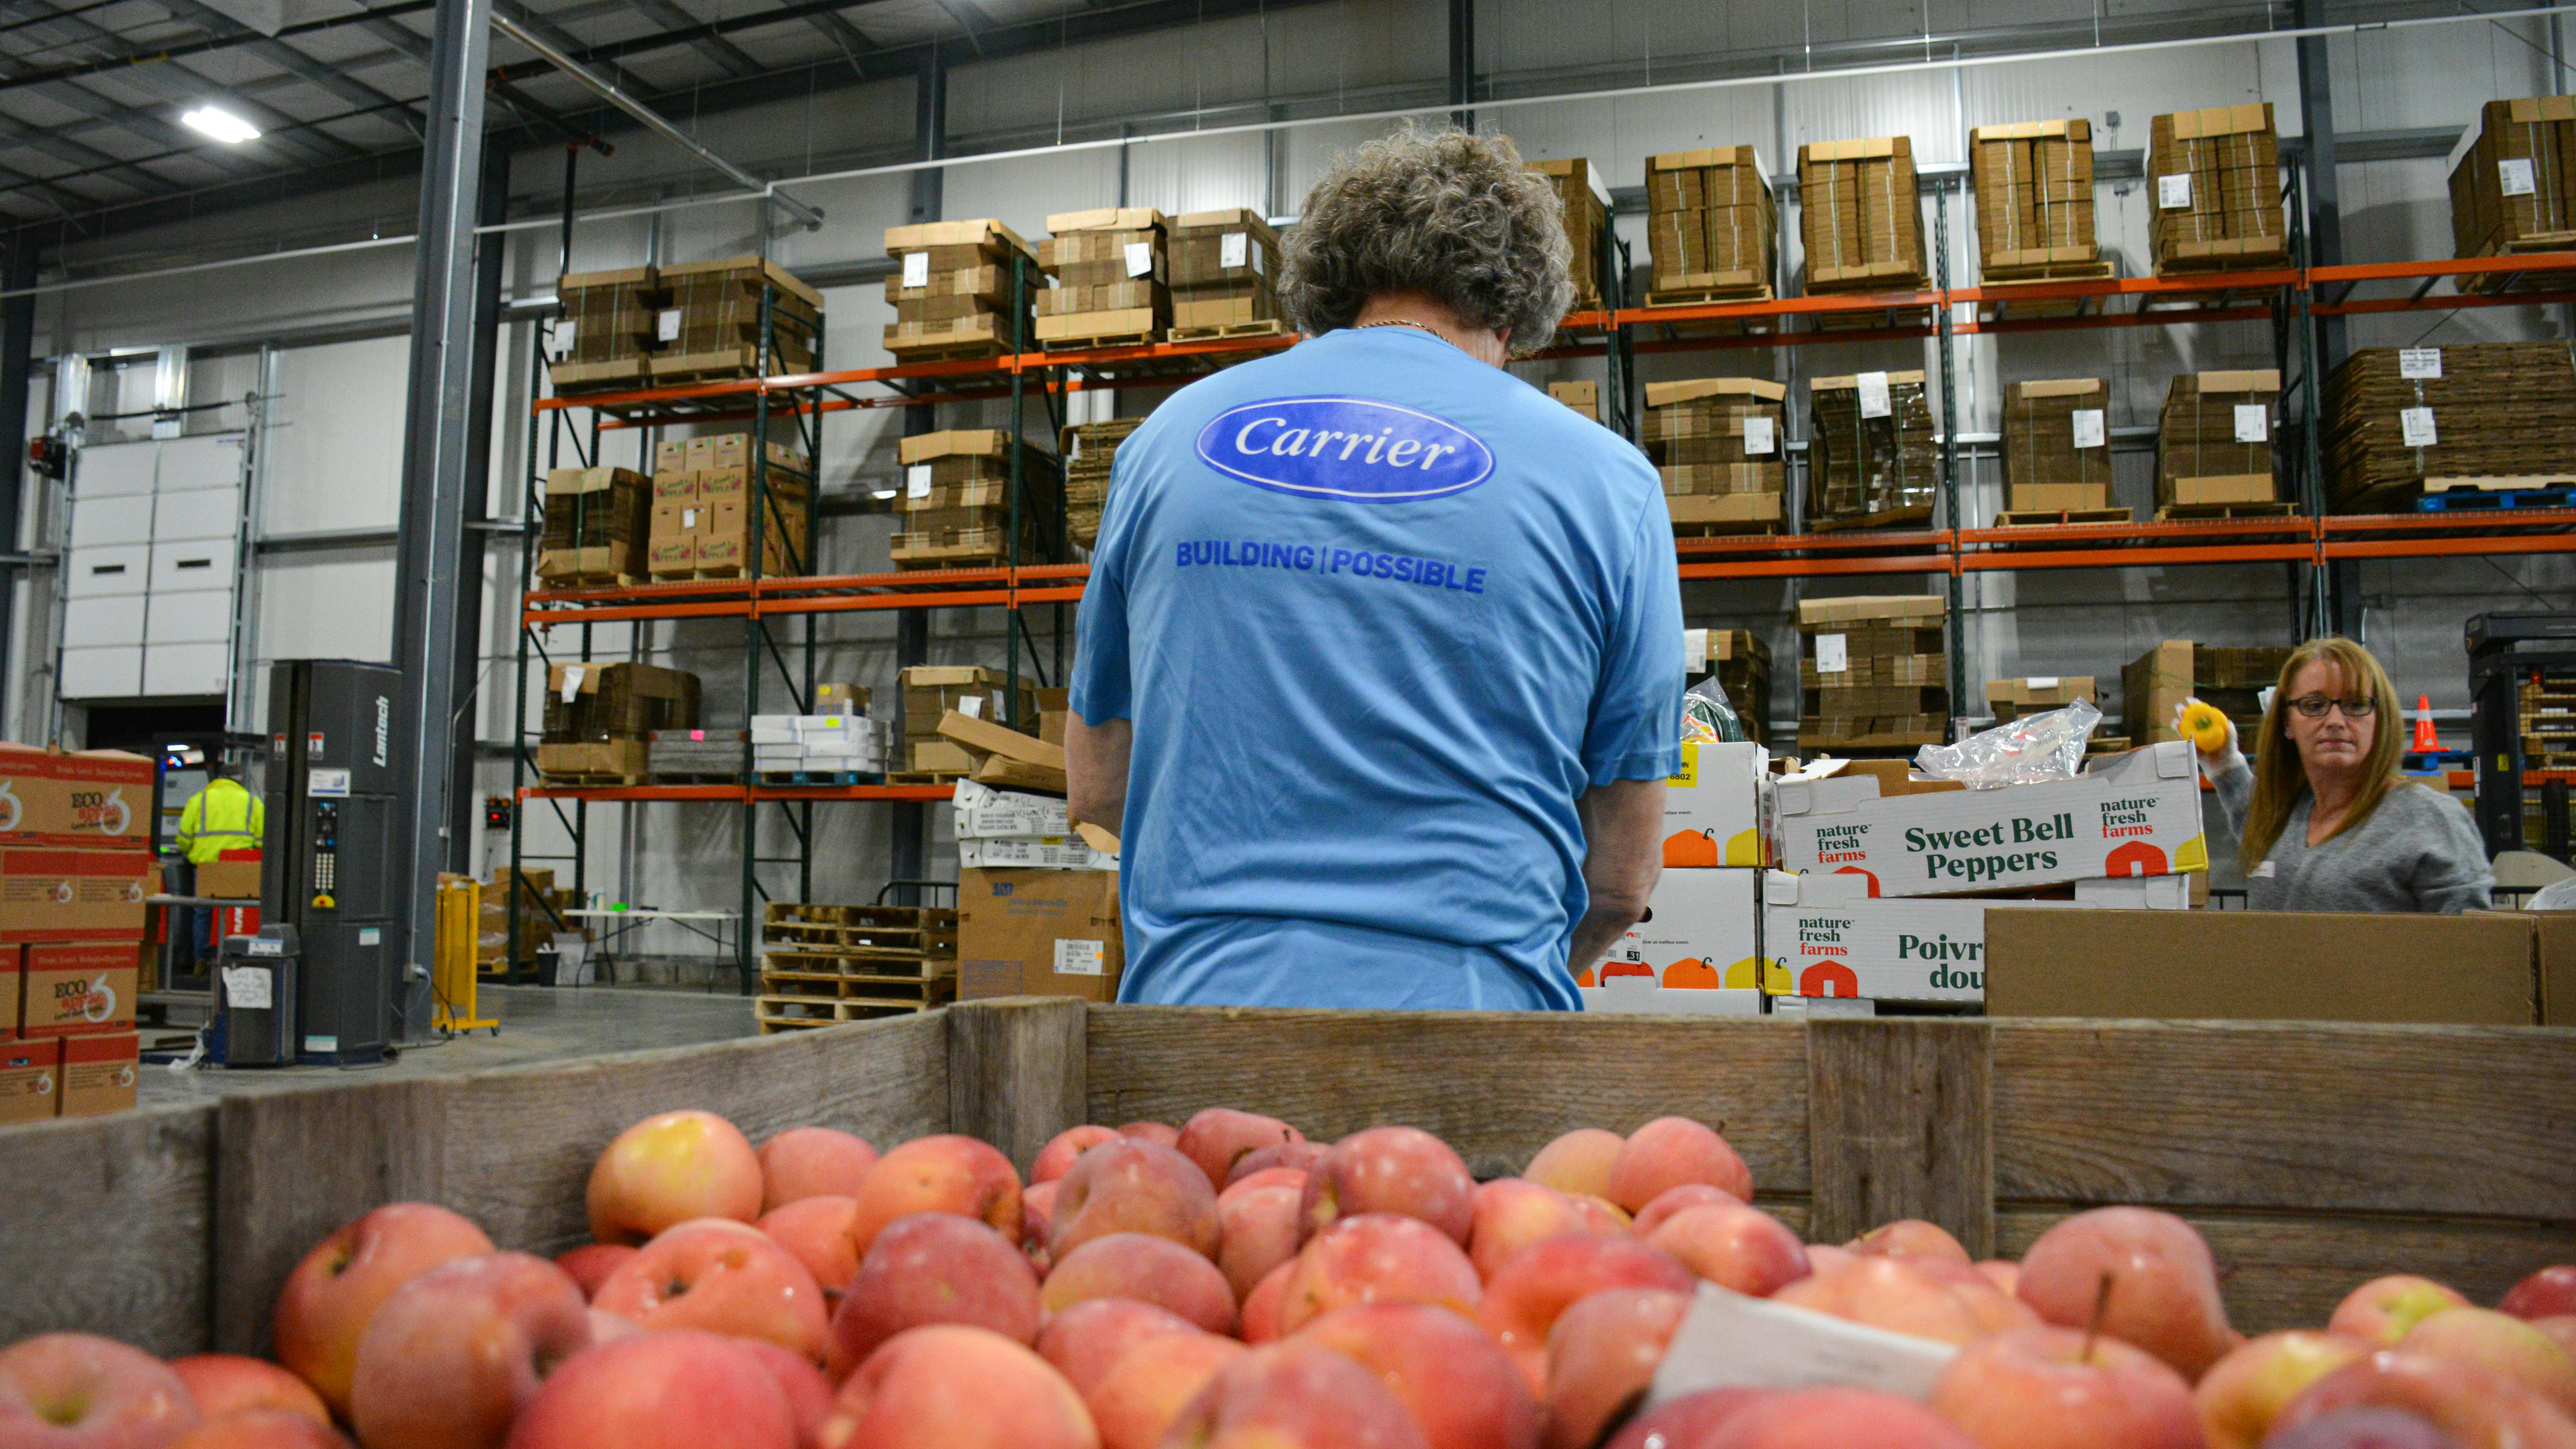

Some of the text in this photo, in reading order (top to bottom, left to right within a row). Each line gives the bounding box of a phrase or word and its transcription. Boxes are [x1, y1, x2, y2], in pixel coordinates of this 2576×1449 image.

[1235, 417, 1455, 471] Carrier
[1176, 541, 1487, 595] BUILDING POSSIBLE
[373, 695, 389, 768] Lantech
[71, 791, 103, 808] ECO
[2100, 798, 2156, 812] nature
[2102, 809, 2147, 826] fresh
[1816, 824, 1868, 838] nature
[1905, 813, 2074, 852] Sweet Bell
[2102, 824, 2153, 838] farms
[1817, 836, 1860, 851] fresh
[1817, 851, 1866, 863] farms
[1926, 850, 2058, 882] Peppers
[1798, 917, 1851, 929] nature
[1798, 929, 1841, 942] fresh
[1800, 942, 1848, 956] farms
[1899, 934, 1984, 960] Poivr
[54, 979, 87, 999] ECO
